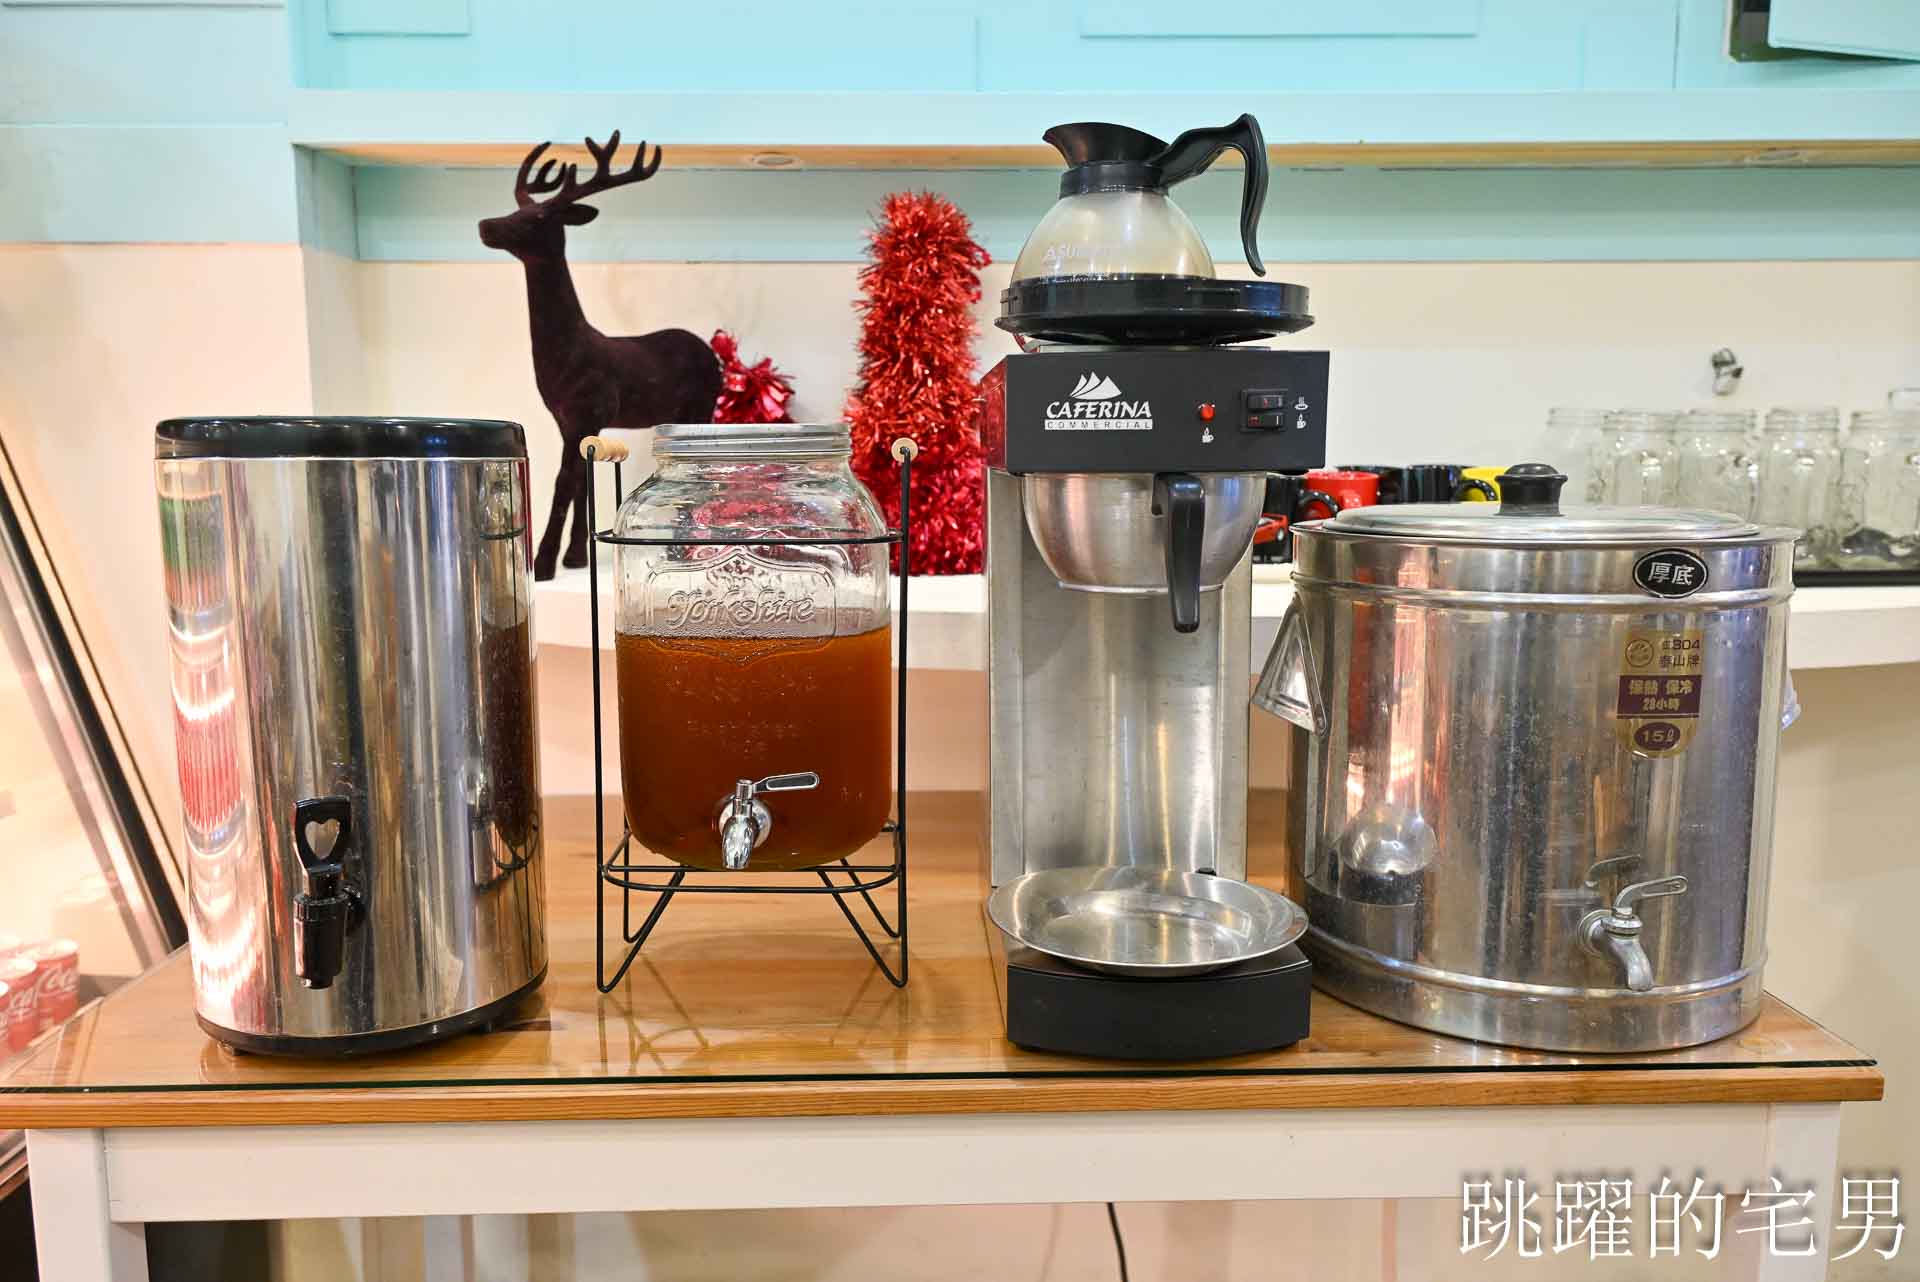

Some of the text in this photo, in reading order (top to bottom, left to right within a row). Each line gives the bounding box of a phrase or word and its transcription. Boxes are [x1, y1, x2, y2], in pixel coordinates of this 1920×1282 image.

[1046, 400, 1152, 419] CAFERINA
[1047, 420, 1151, 429] COMMERCIAL
[1648, 562, 1695, 585] 厚底
